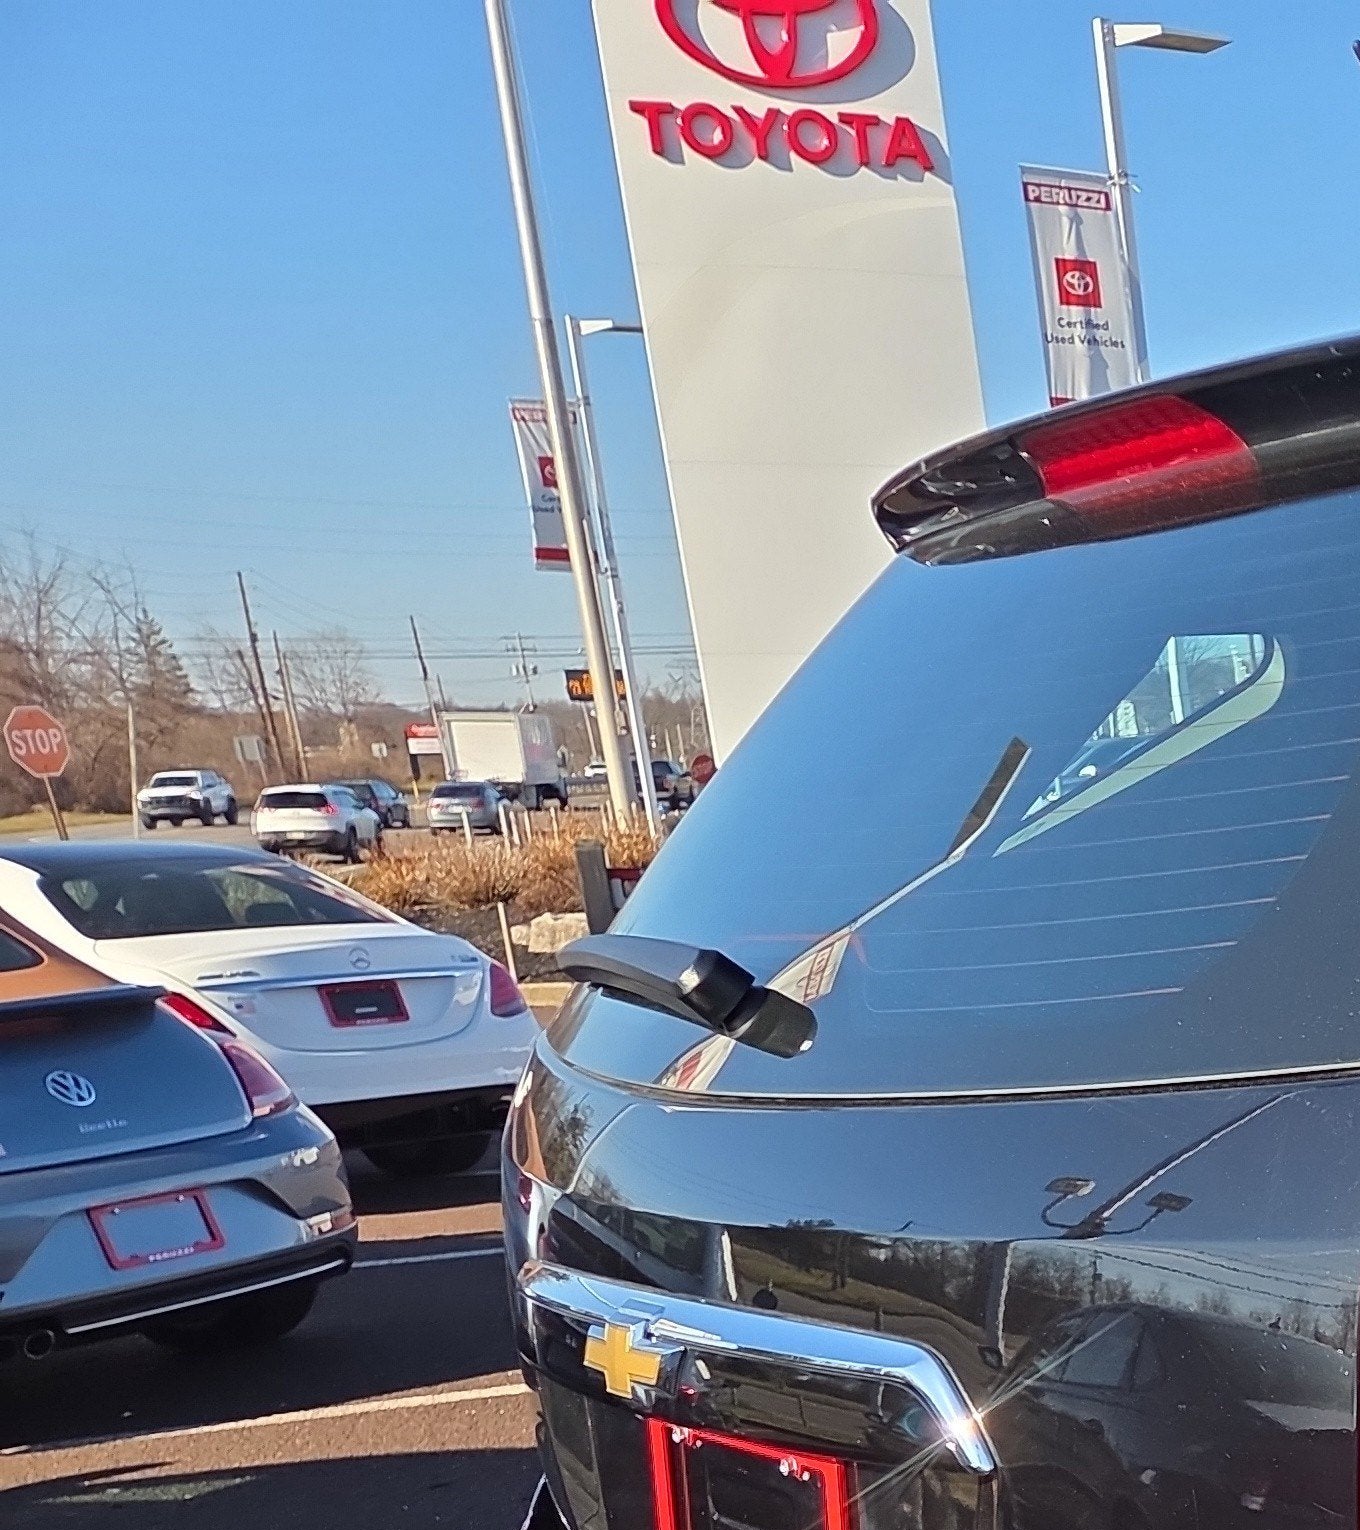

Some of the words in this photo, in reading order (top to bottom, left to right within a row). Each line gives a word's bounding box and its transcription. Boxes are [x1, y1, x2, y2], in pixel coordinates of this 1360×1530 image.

[629, 99, 935, 172] TOYOTA
[1026, 184, 1107, 210] PERUZZI
[1056, 316, 1110, 332] Certified
[1044, 331, 1075, 345] Used
[1077, 334, 1126, 349] Vehicles
[11, 728, 63, 756] STOP
